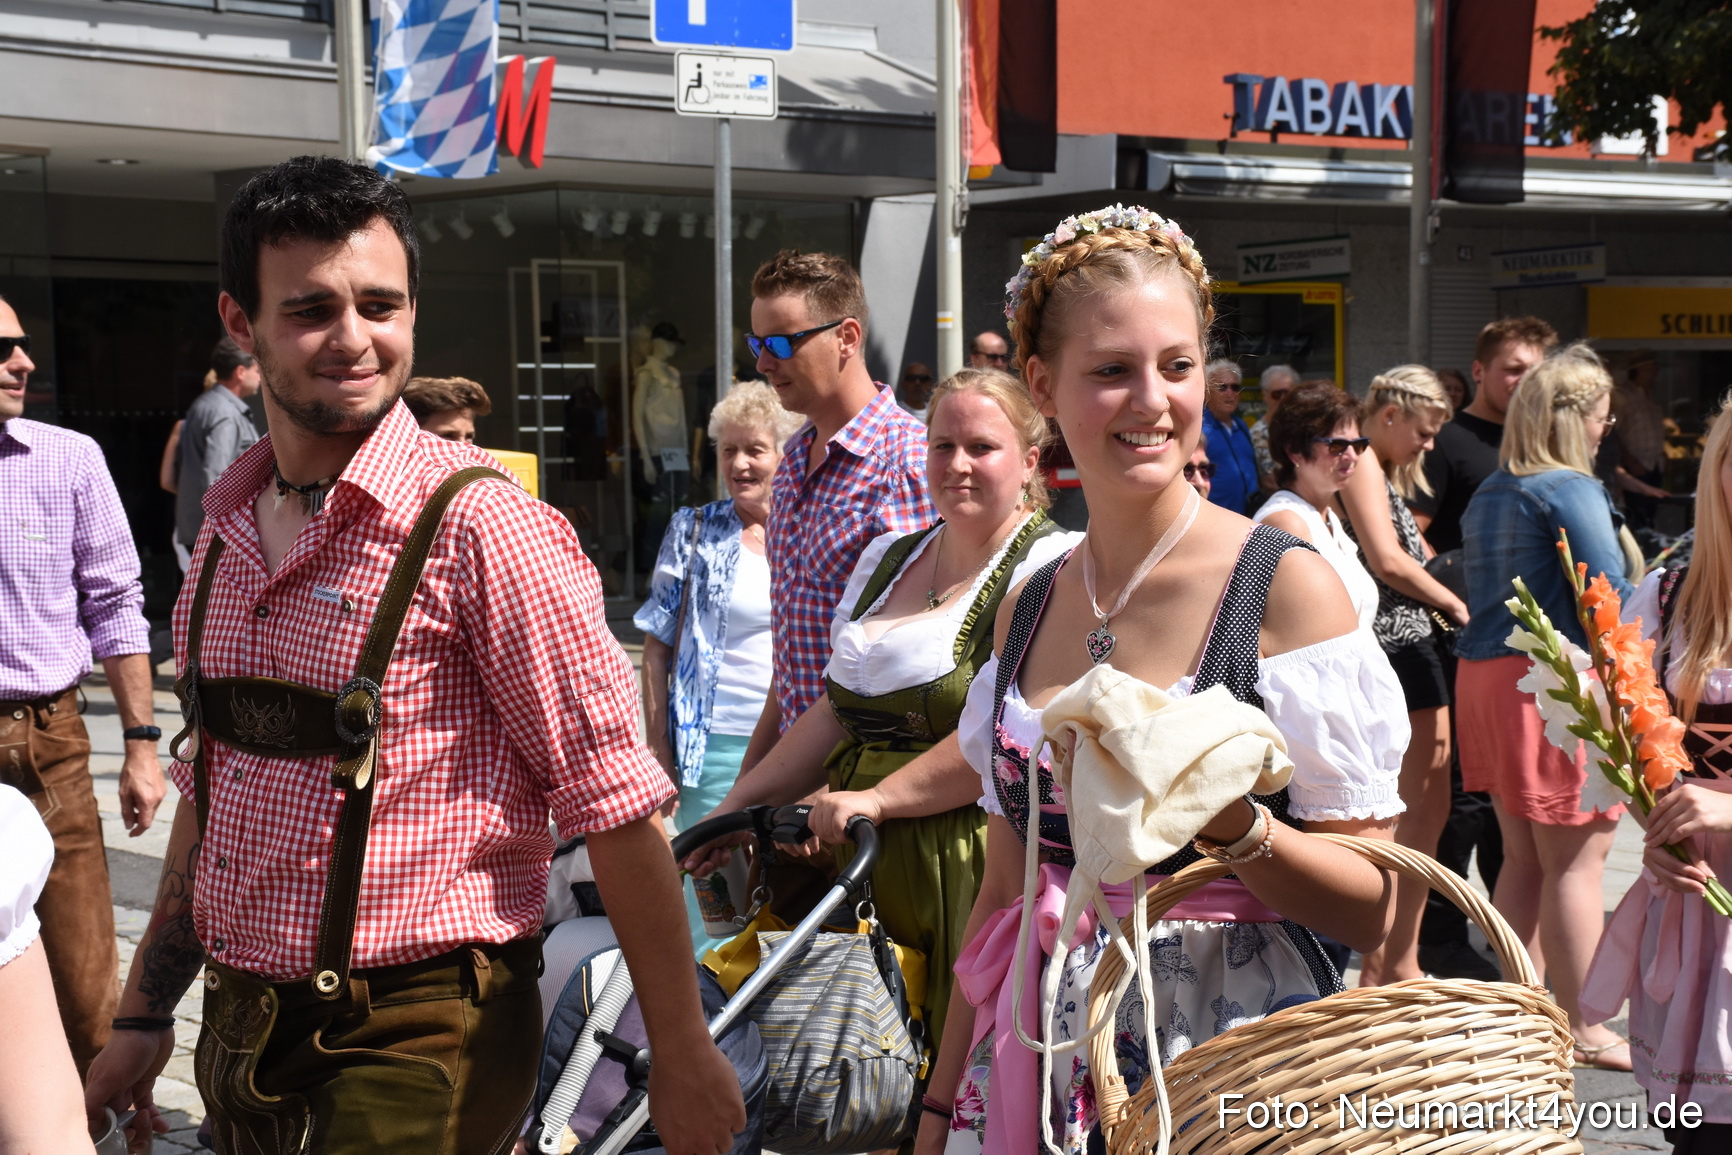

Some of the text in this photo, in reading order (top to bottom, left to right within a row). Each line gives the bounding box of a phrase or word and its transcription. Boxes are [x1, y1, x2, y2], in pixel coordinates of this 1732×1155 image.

[1243, 253, 1277, 274] NZ
[1503, 249, 1594, 270] NEUMARKTER
[1661, 314, 1732, 334] SCHLI
